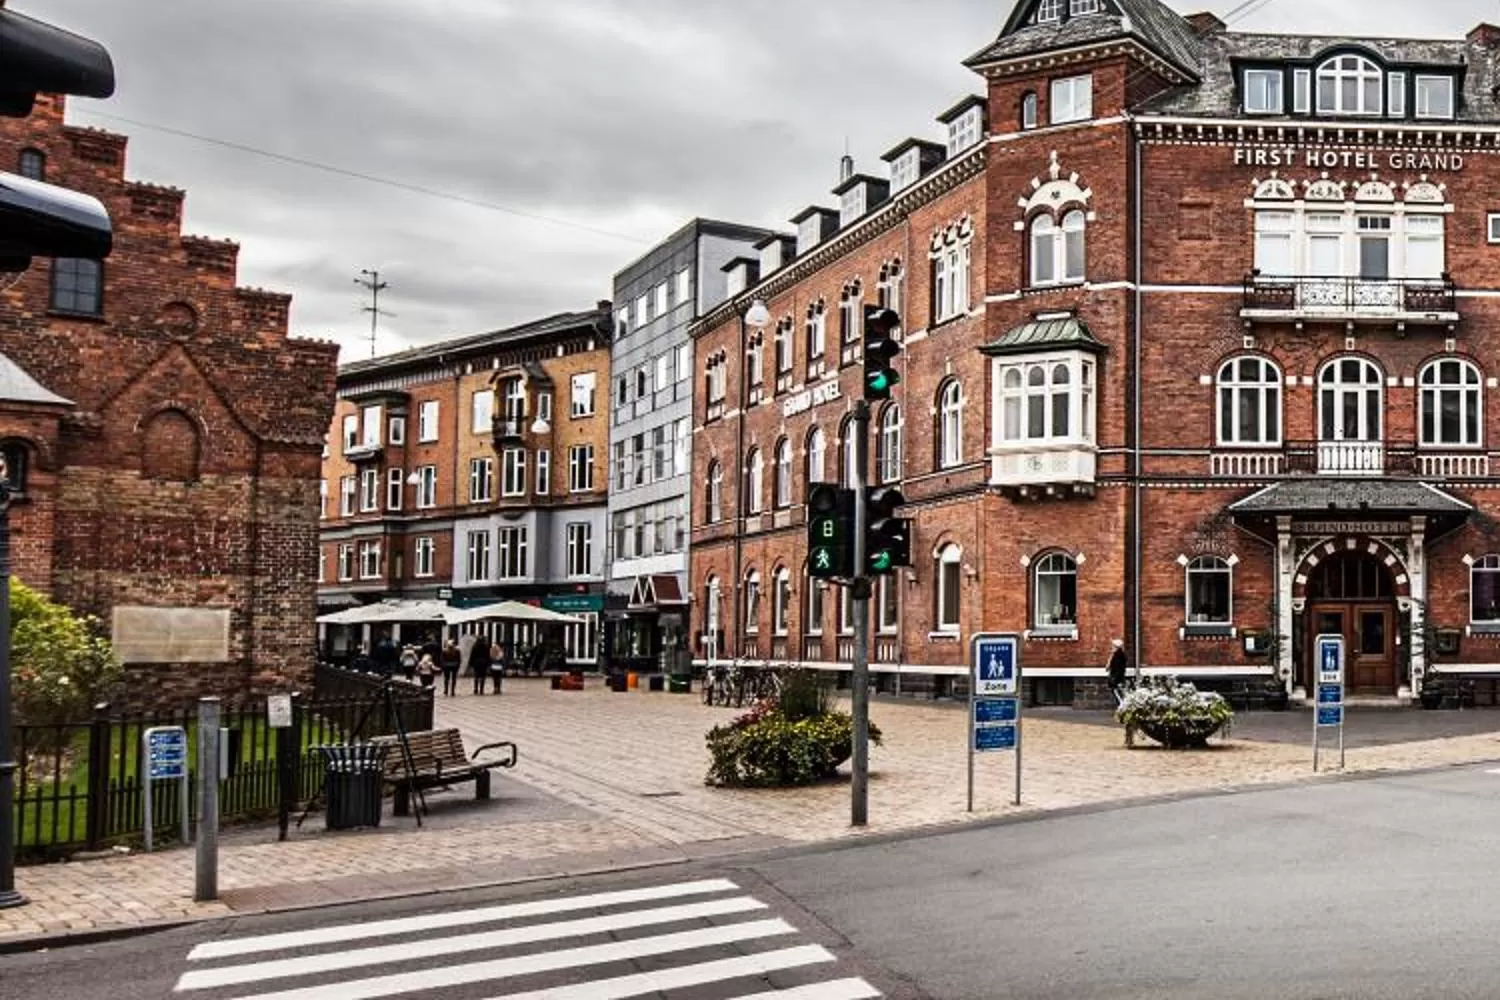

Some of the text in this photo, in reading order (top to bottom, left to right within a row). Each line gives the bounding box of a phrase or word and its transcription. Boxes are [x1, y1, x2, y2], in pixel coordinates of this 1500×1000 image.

[1234, 149, 1464, 171] FIRST HOTEL GRAND
